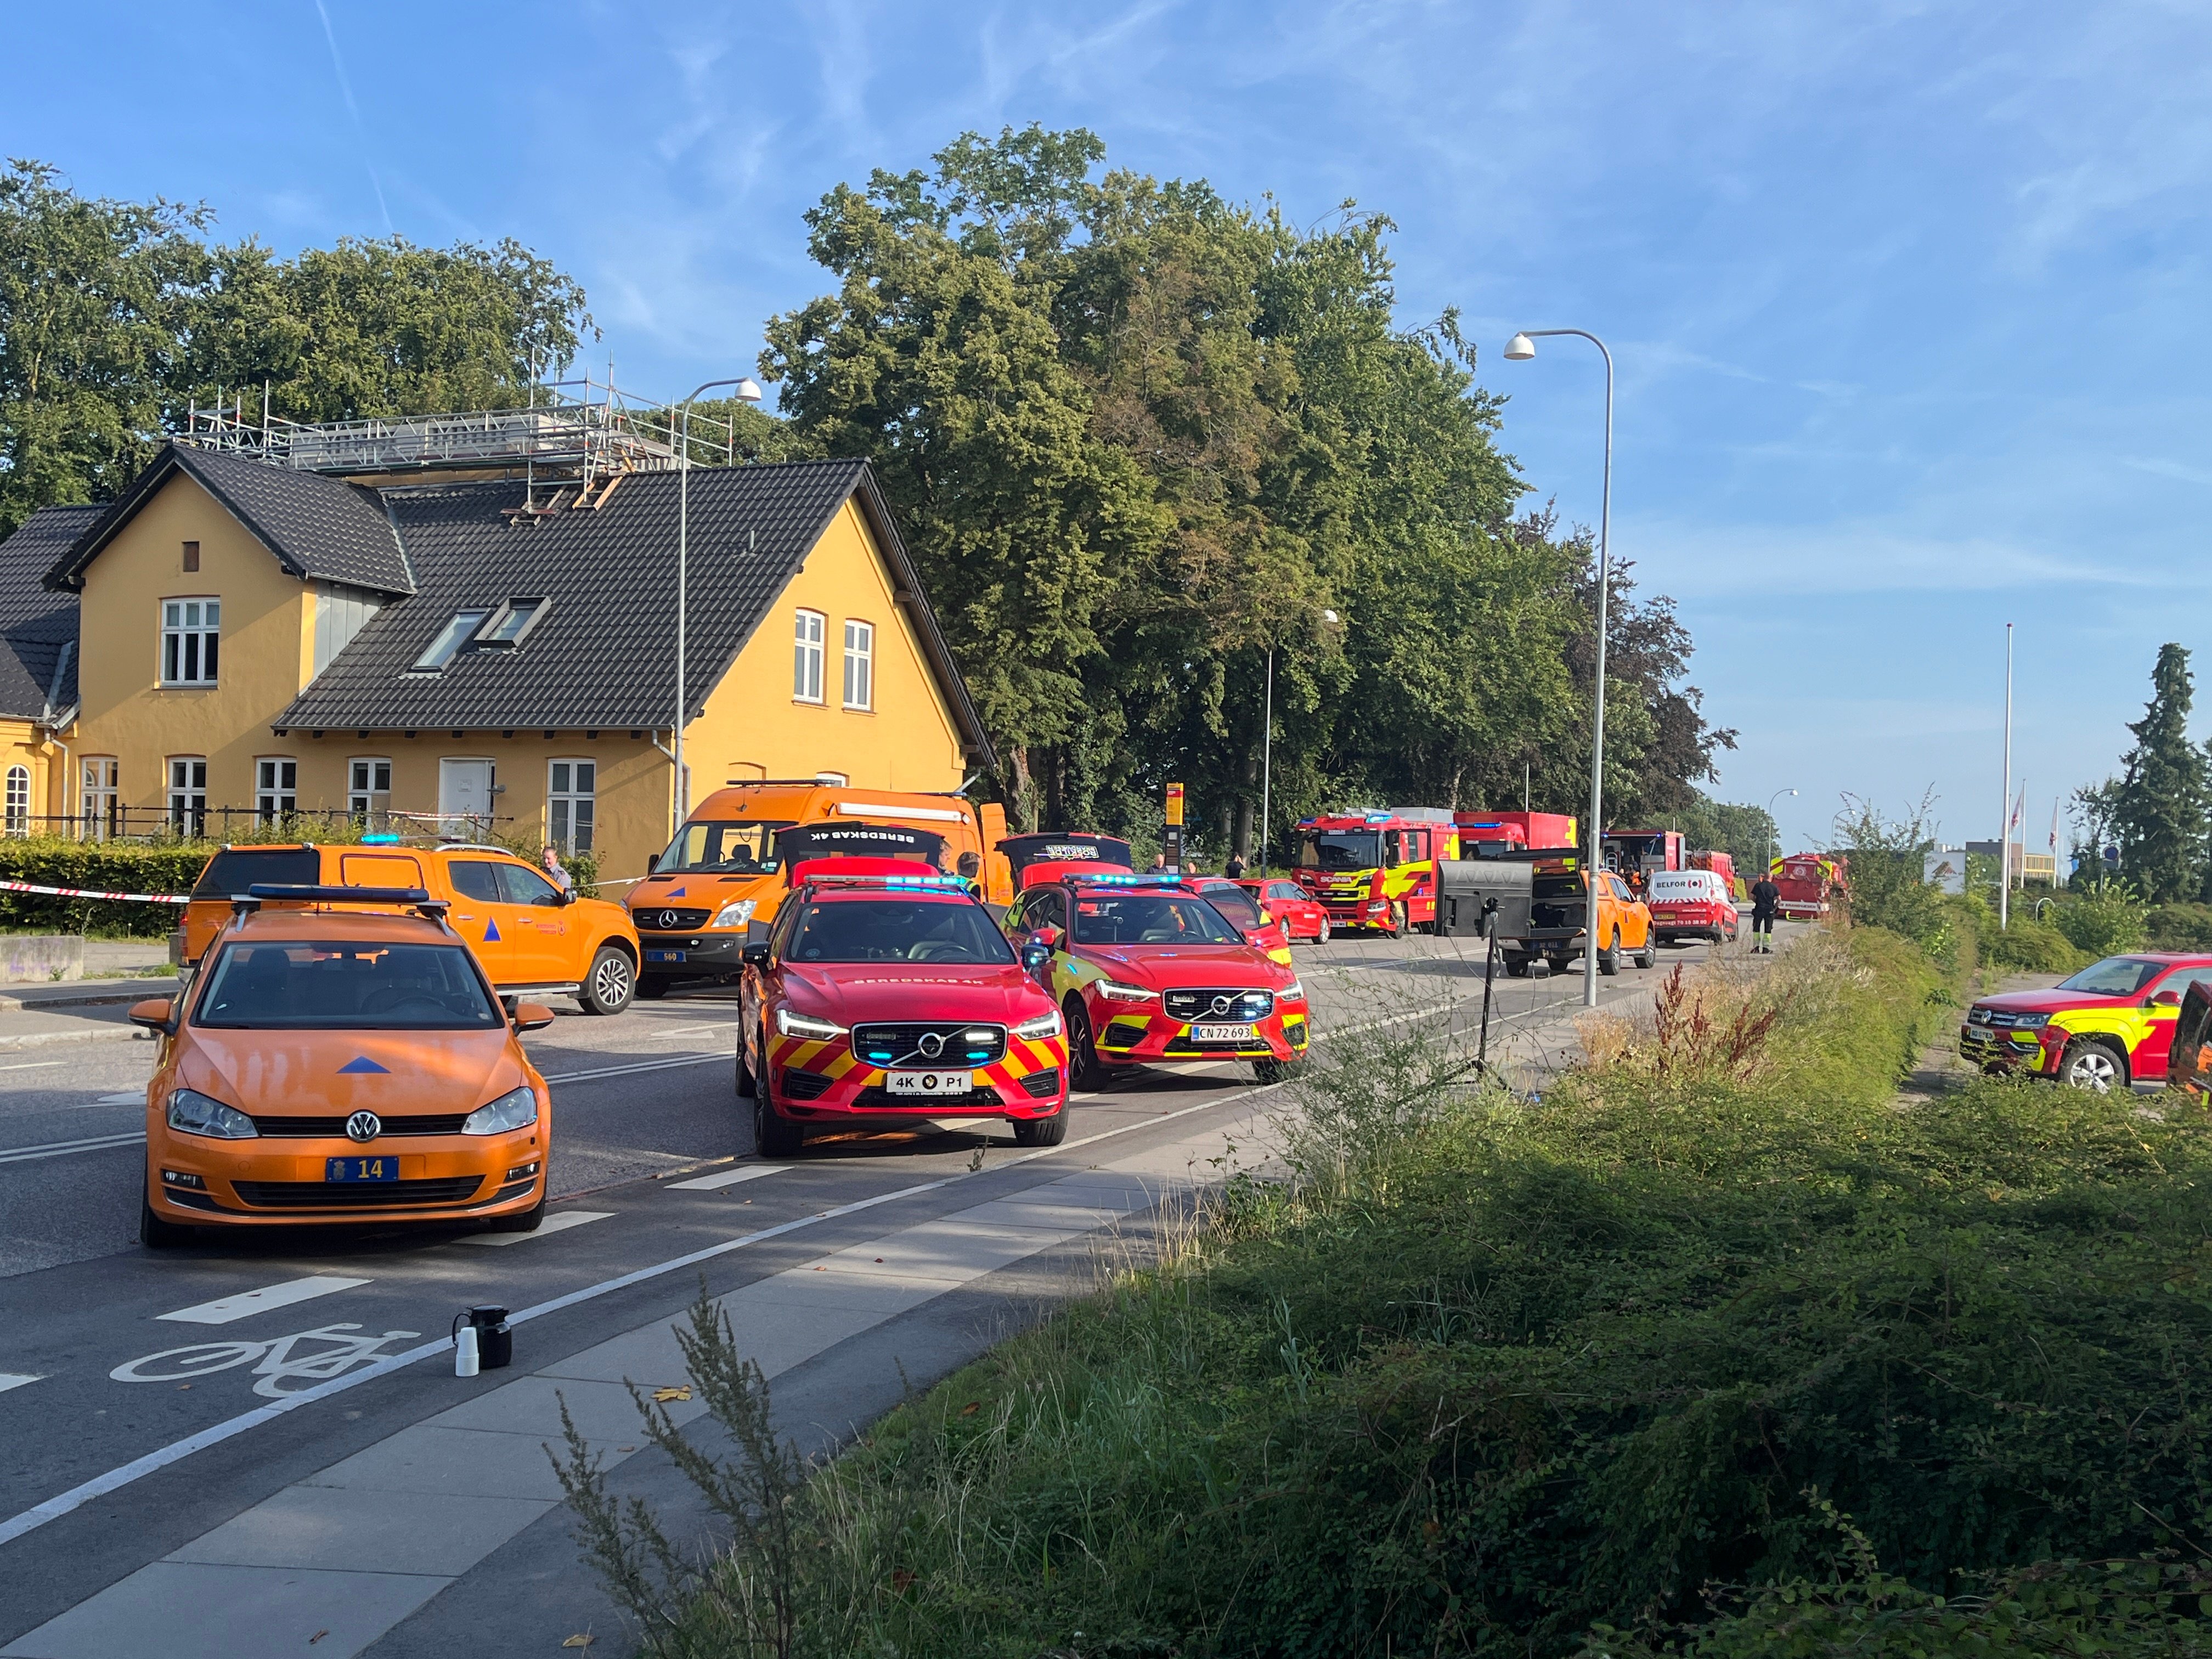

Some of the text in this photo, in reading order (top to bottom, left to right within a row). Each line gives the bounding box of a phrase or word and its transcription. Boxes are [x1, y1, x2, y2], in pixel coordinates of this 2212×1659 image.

[811, 831, 915, 843] BEREDSKAB 4K
[1200, 1028, 1250, 1038] CN 72 693
[896, 1077, 962, 1087] 4K P1
[358, 1160, 382, 1178] 14
